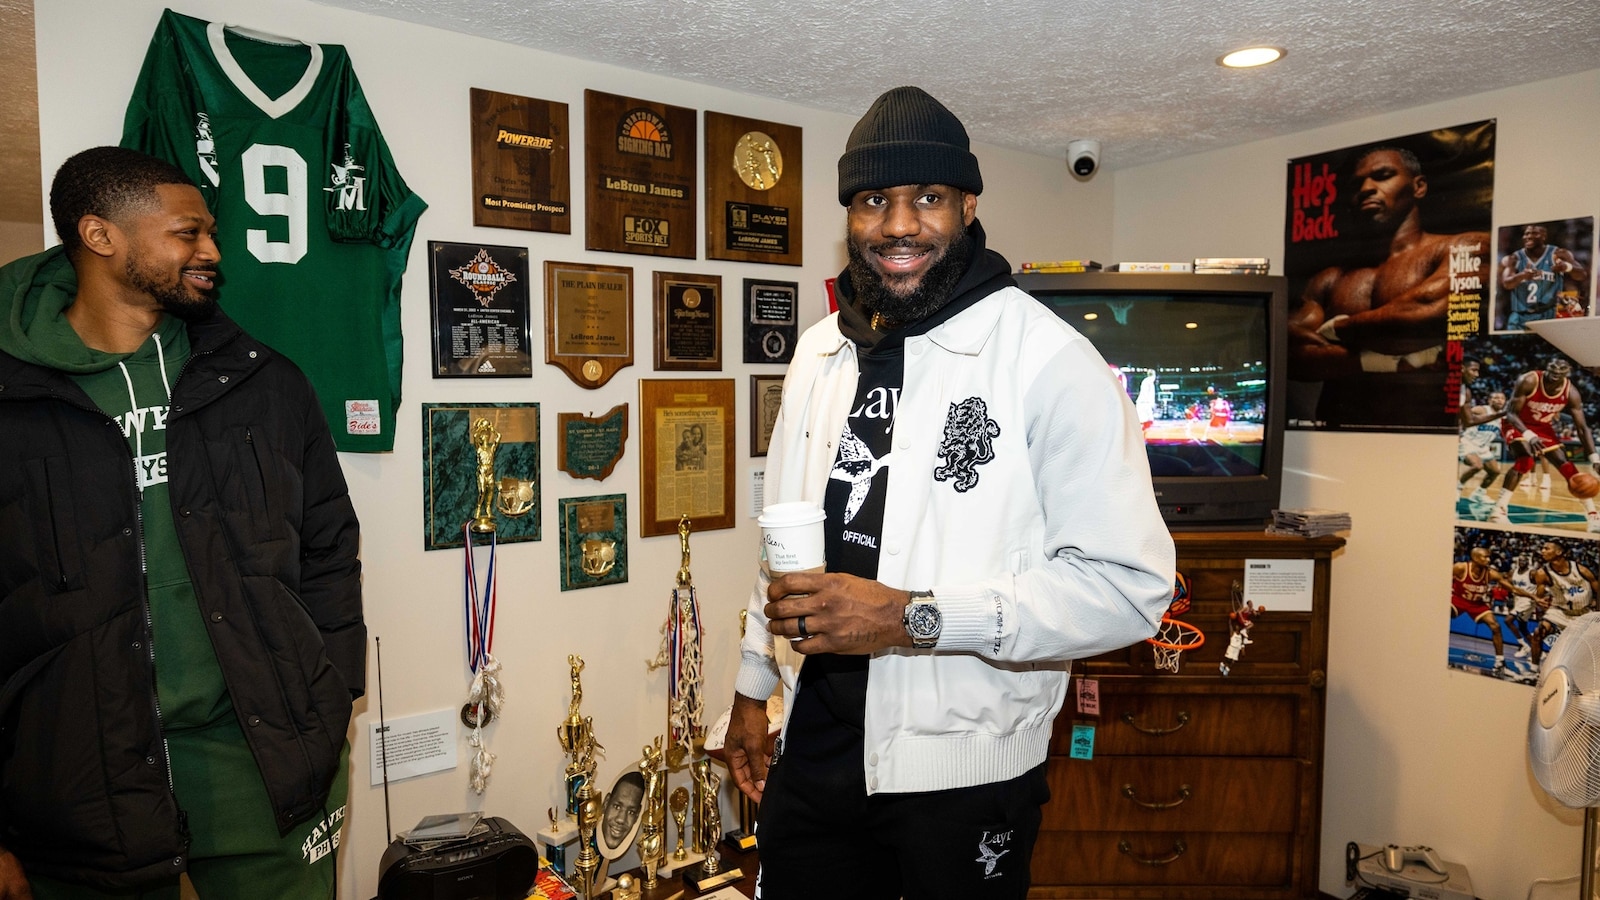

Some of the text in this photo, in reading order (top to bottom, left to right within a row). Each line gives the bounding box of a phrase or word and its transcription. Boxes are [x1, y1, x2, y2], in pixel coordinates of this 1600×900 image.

[622, 111, 669, 142] COUNTDOWN TO
[618, 136, 672, 158] SIGNING DAY
[606, 177, 684, 198] LeBron James
[1293, 162, 1337, 208] He's
[242, 143, 308, 265] 9
[485, 197, 564, 213] Most Promising Prospect
[752, 213, 787, 222] PLAYER
[1292, 205, 1339, 242] Back.
[625, 231, 668, 244] SPORTS NET
[1449, 252, 1482, 274] Mike
[462, 271, 505, 282] ROUNDBALL
[562, 280, 623, 291] THE PLAIN DEALER
[1449, 274, 1482, 294] Tyson.
[1526, 283, 1539, 303] 2
[663, 408, 718, 417] He's something special
[842, 530, 878, 549] OFFICIAL
[980, 830, 1013, 846] Layr
[457, 874, 474, 882] SONY
